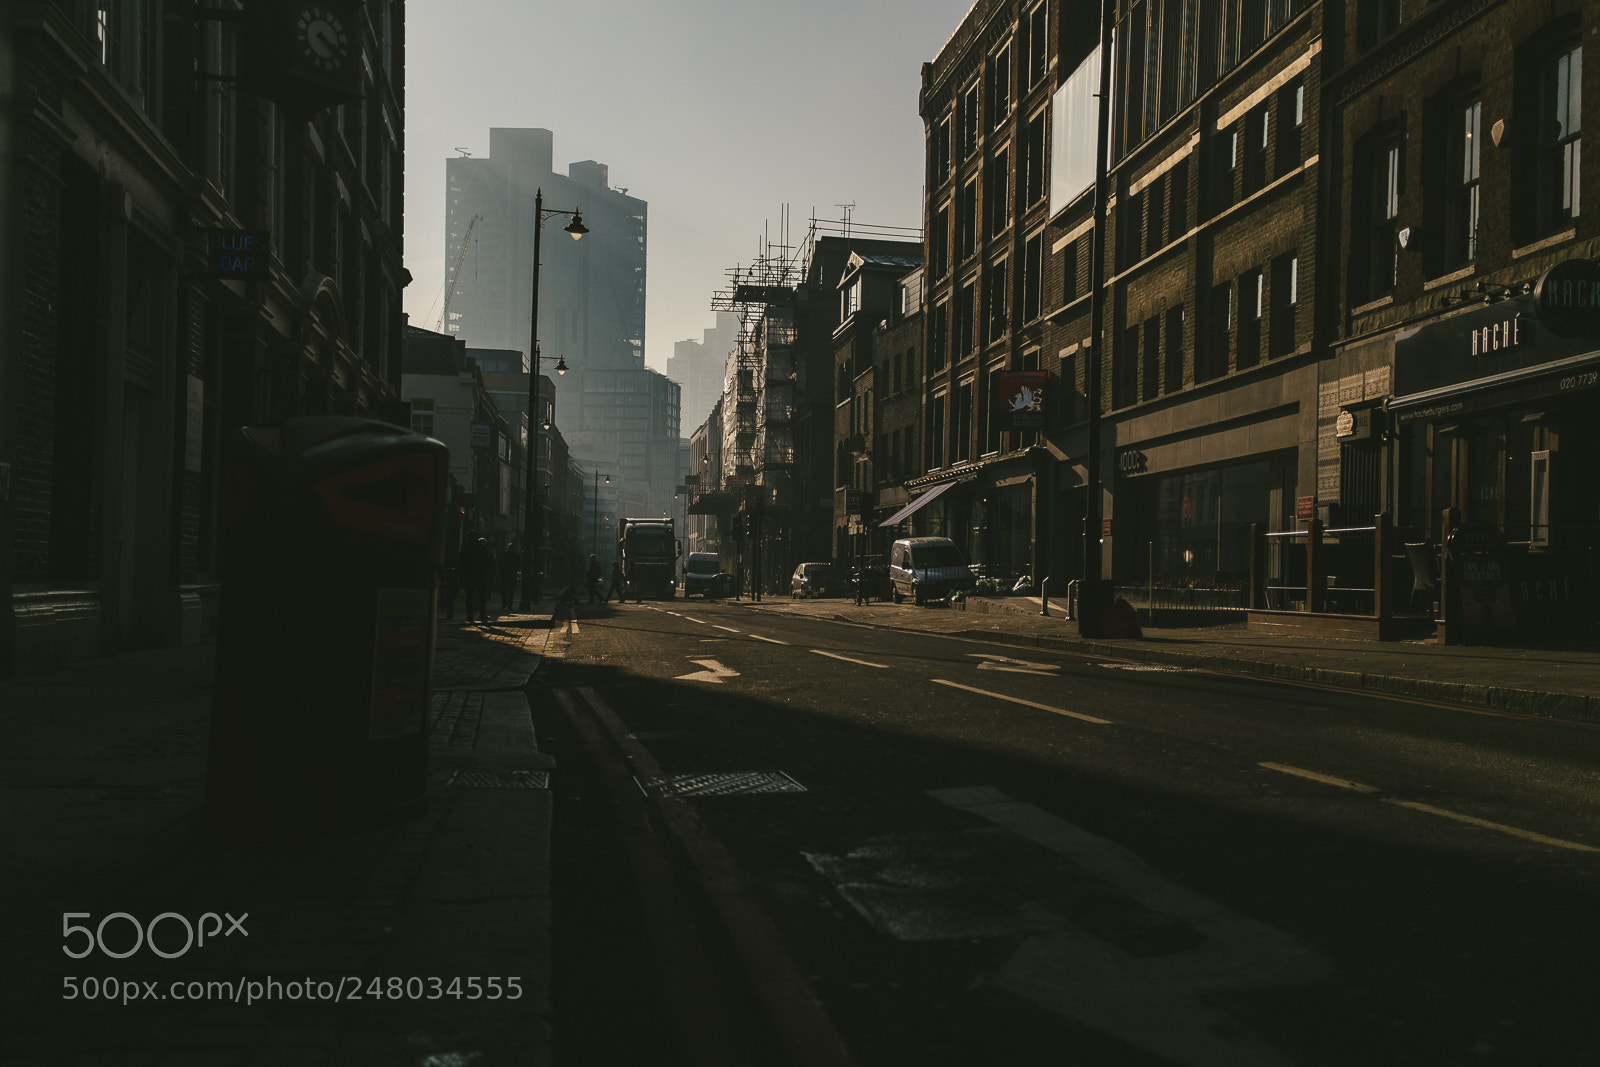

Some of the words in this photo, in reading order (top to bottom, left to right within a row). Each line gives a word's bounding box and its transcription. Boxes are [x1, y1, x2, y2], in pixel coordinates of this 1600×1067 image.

[211, 233, 265, 251] BLUES
[221, 256, 256, 272] BAR
[1472, 312, 1520, 356] HACHÉ
[1560, 376, 1576, 390] 020
[1578, 371, 1598, 387] 7739
[1521, 577, 1571, 601] ACHÉ
